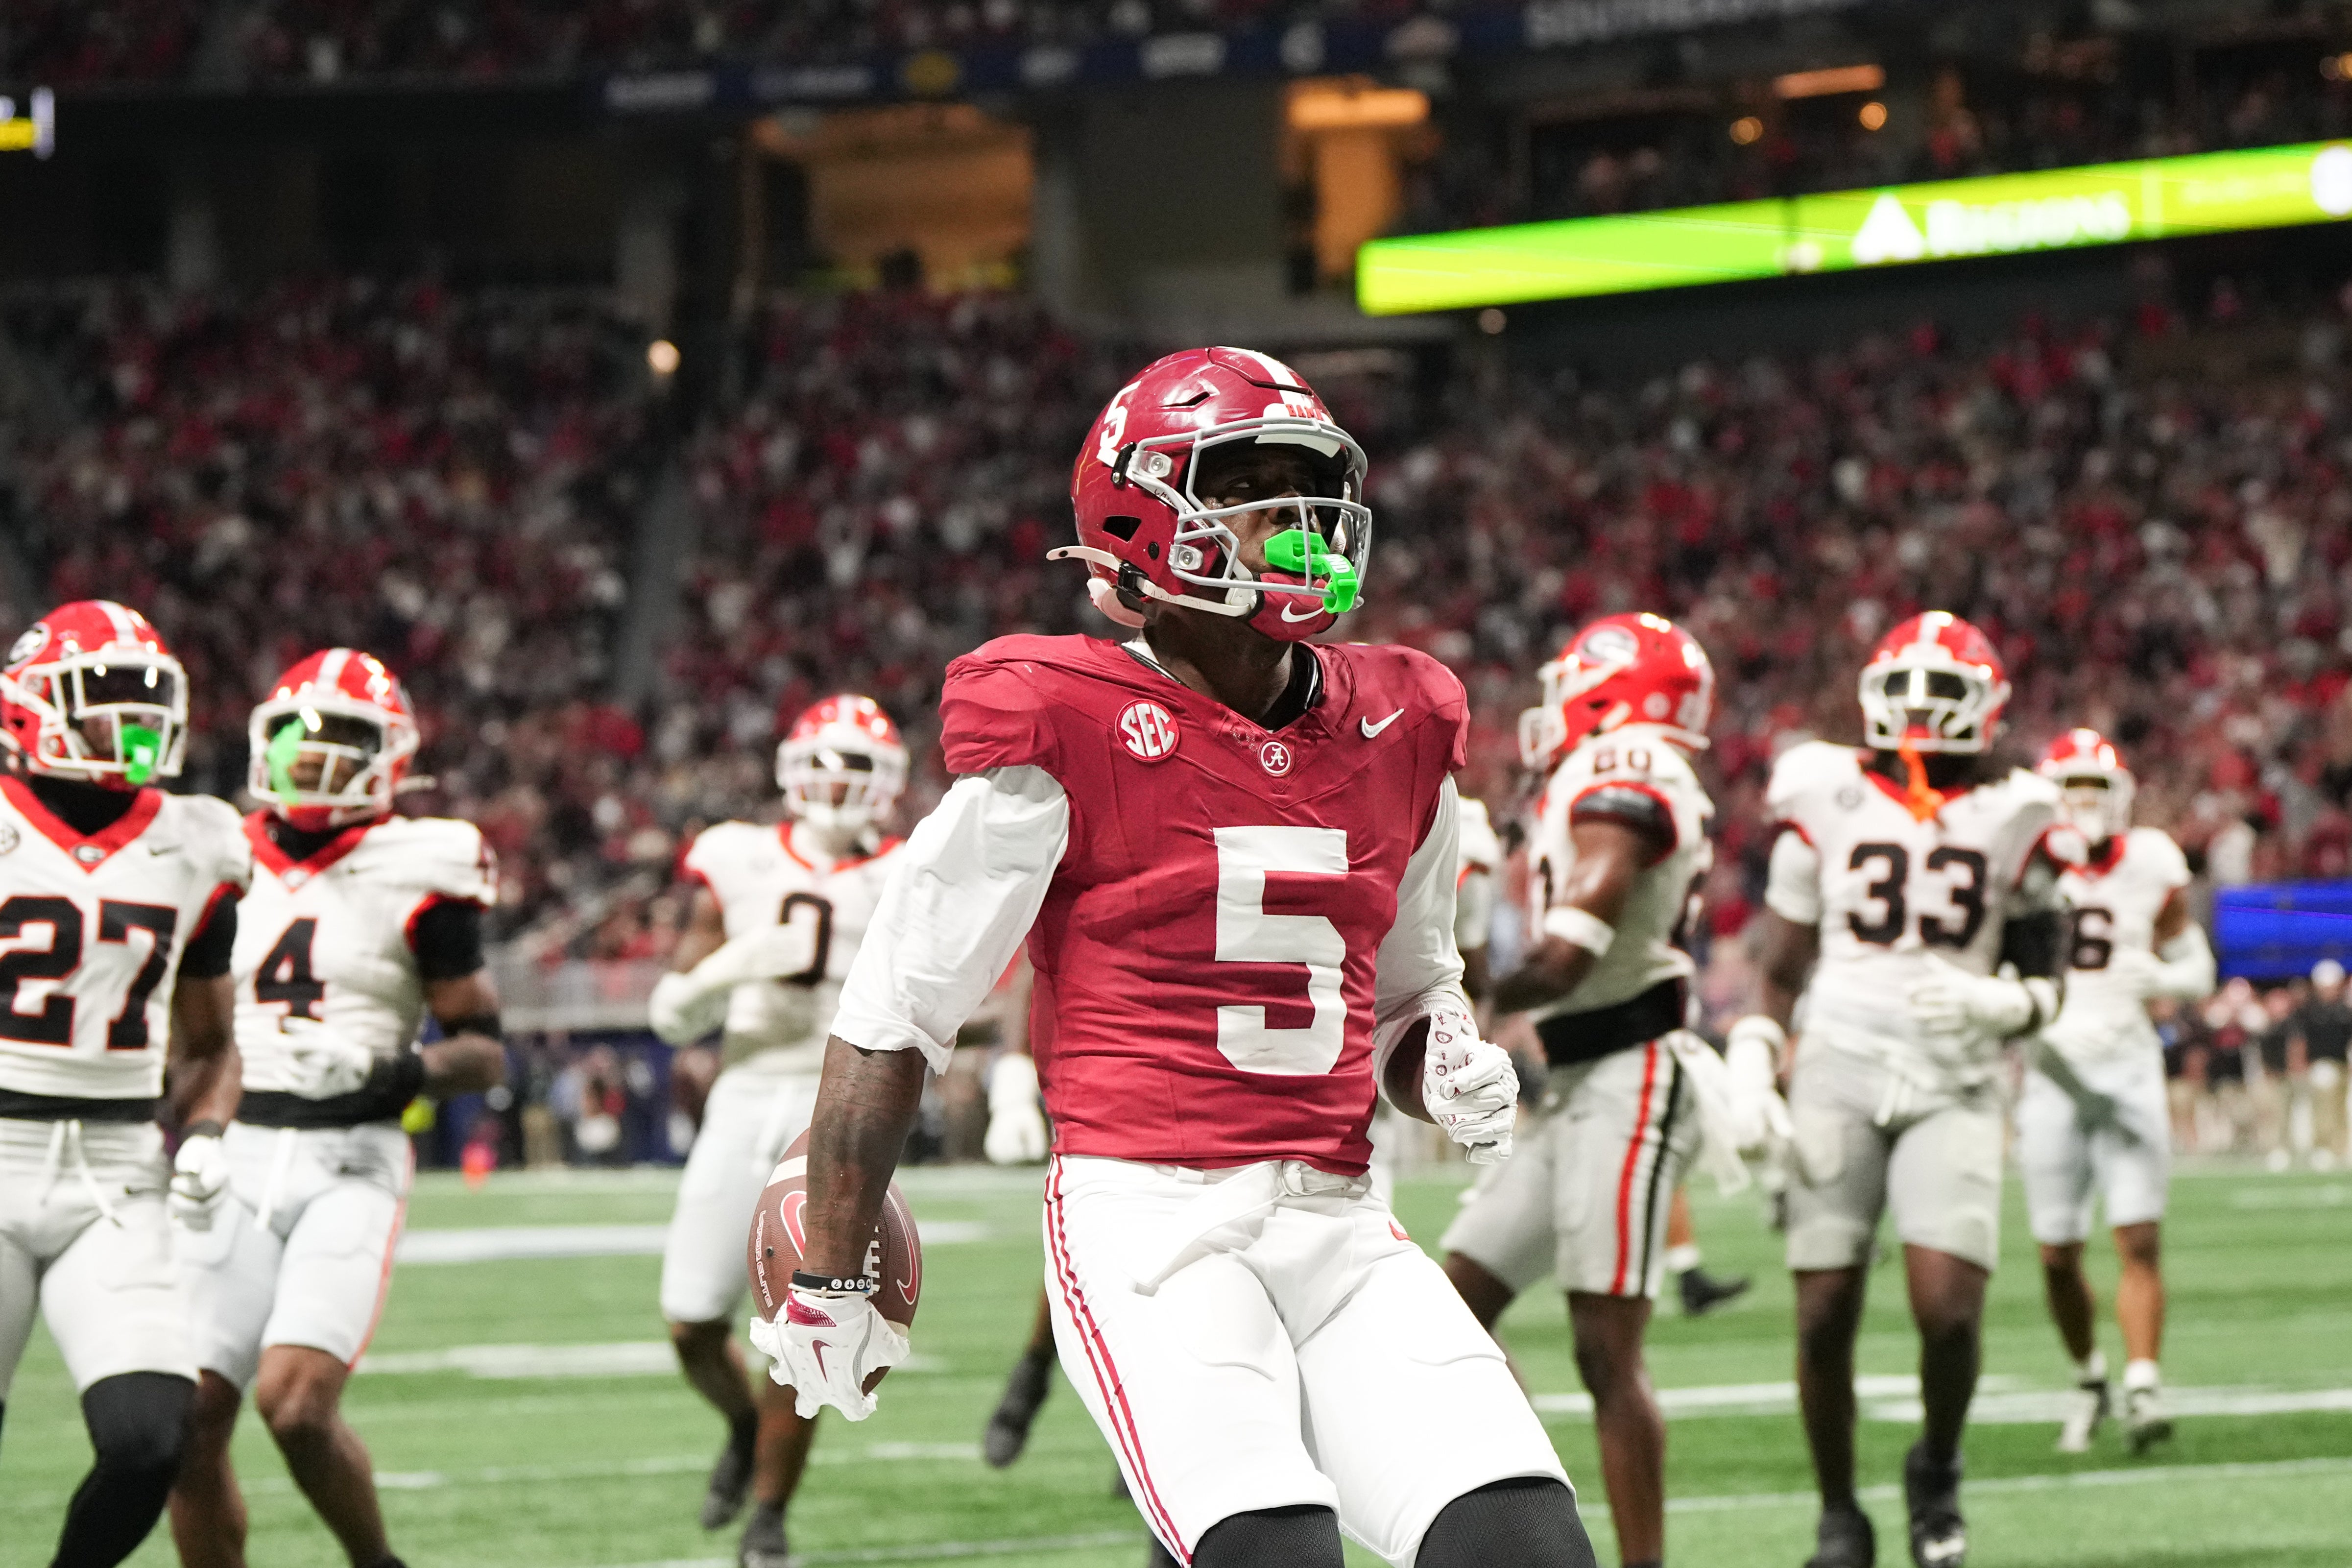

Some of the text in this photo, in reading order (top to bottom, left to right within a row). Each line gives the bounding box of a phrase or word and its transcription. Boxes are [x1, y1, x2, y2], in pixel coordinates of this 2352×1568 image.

[1097, 381, 1141, 468] 5
[1285, 404, 1325, 421] BAMA
[1120, 702, 1175, 757] SEC
[1848, 842, 1989, 949] 33
[2068, 907, 2113, 971] 6
[0, 895, 177, 1050] 27
[254, 917, 325, 1033] 4
[1212, 825, 1349, 1076] 5
[755, 1210, 773, 1308] VAPOR ELITE
